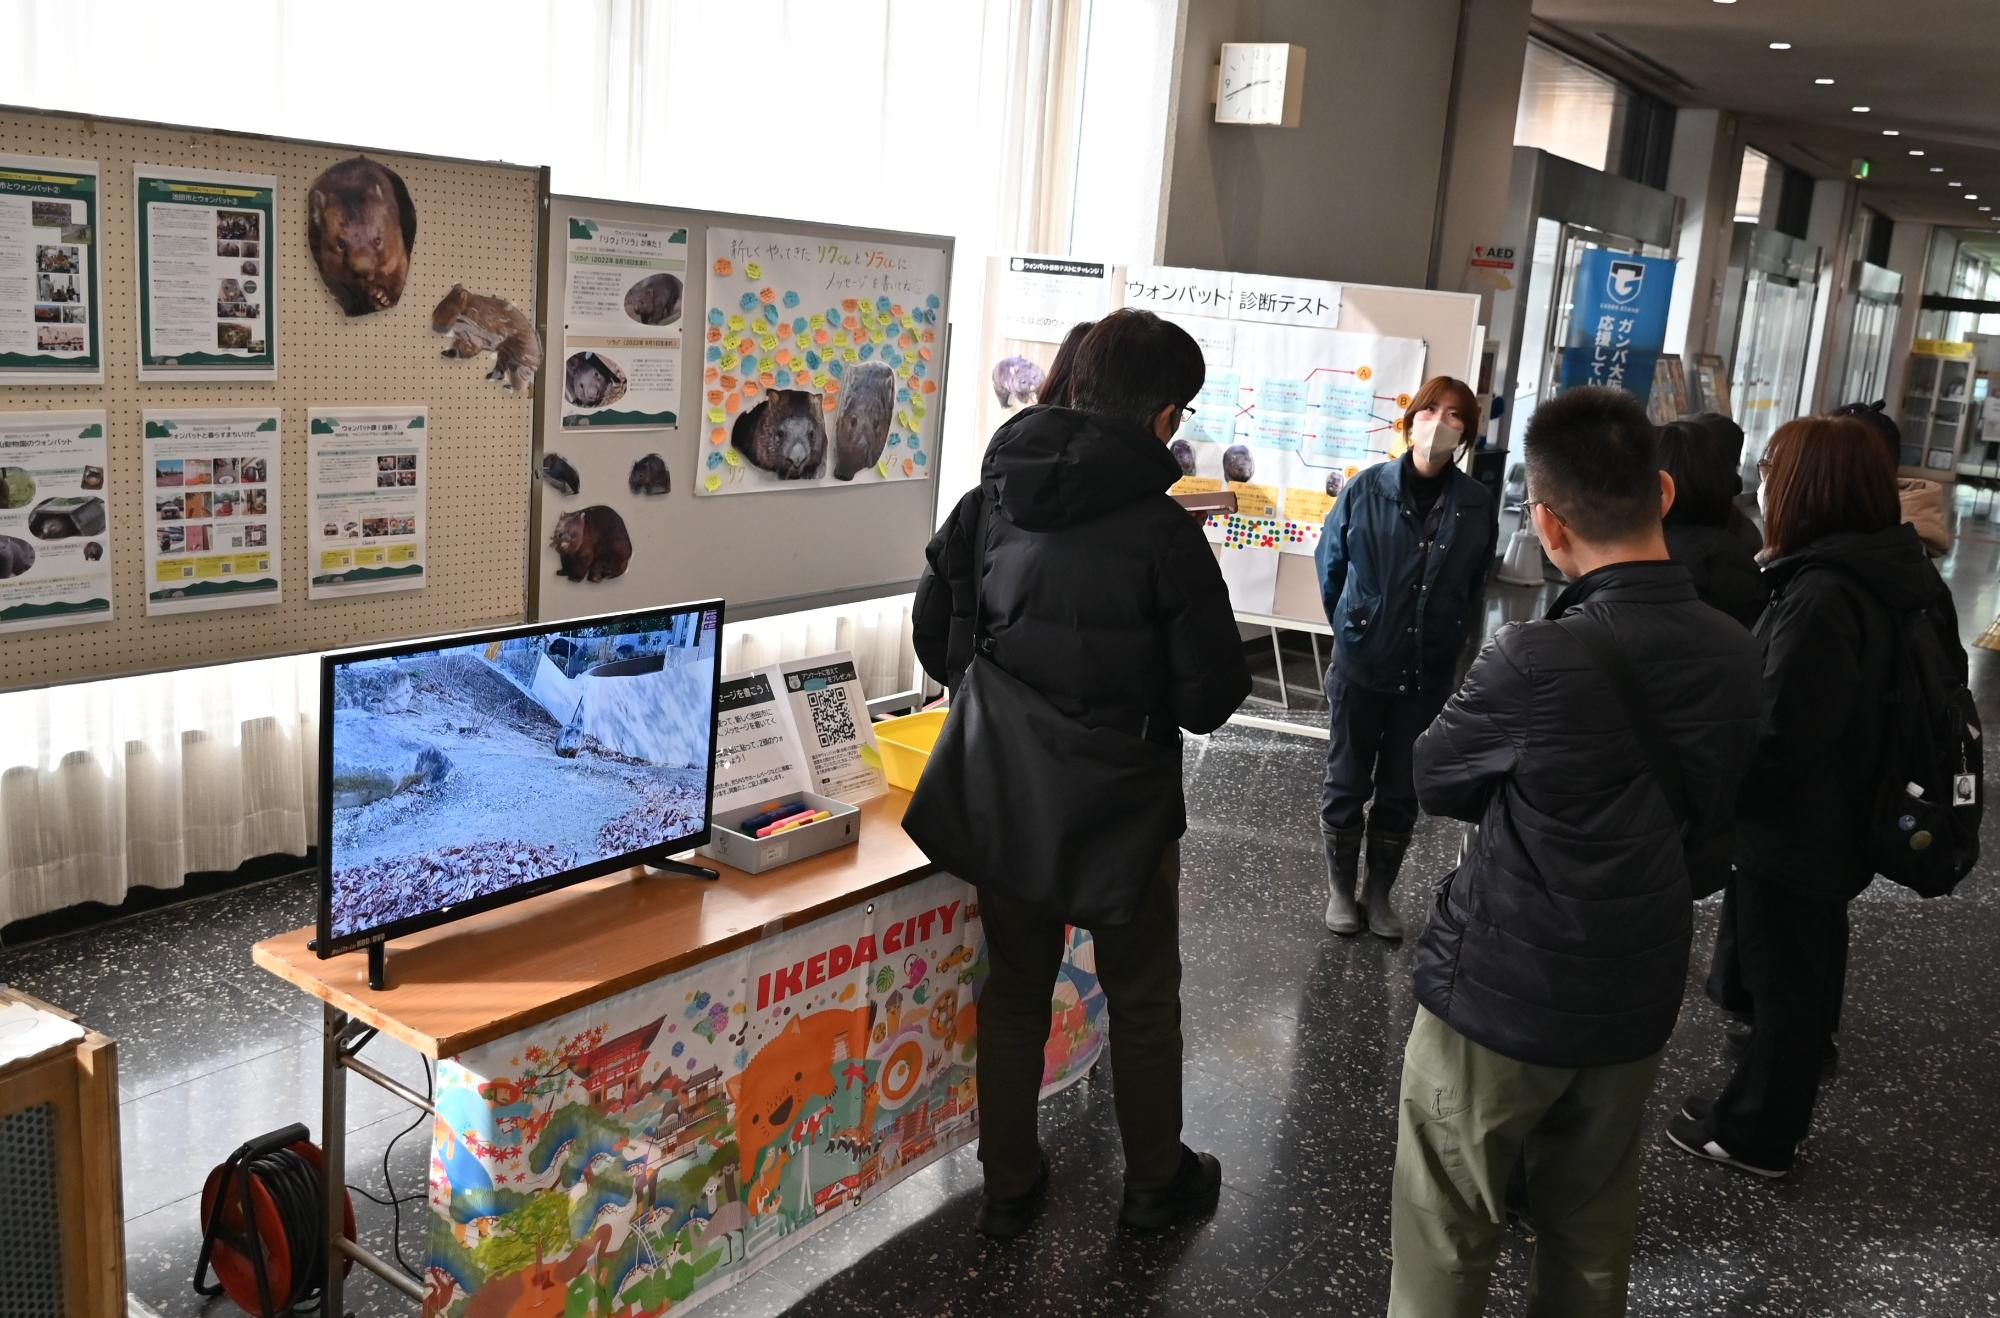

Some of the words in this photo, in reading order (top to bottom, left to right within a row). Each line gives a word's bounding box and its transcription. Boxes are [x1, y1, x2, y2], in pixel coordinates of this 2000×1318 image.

[1486, 247, 1514, 259] AED
[1129, 281, 1226, 307] ウォンバット
[1239, 291, 1331, 318] 診断テスト
[757, 934, 878, 1012] IKEDA
[882, 900, 961, 955] CITY
